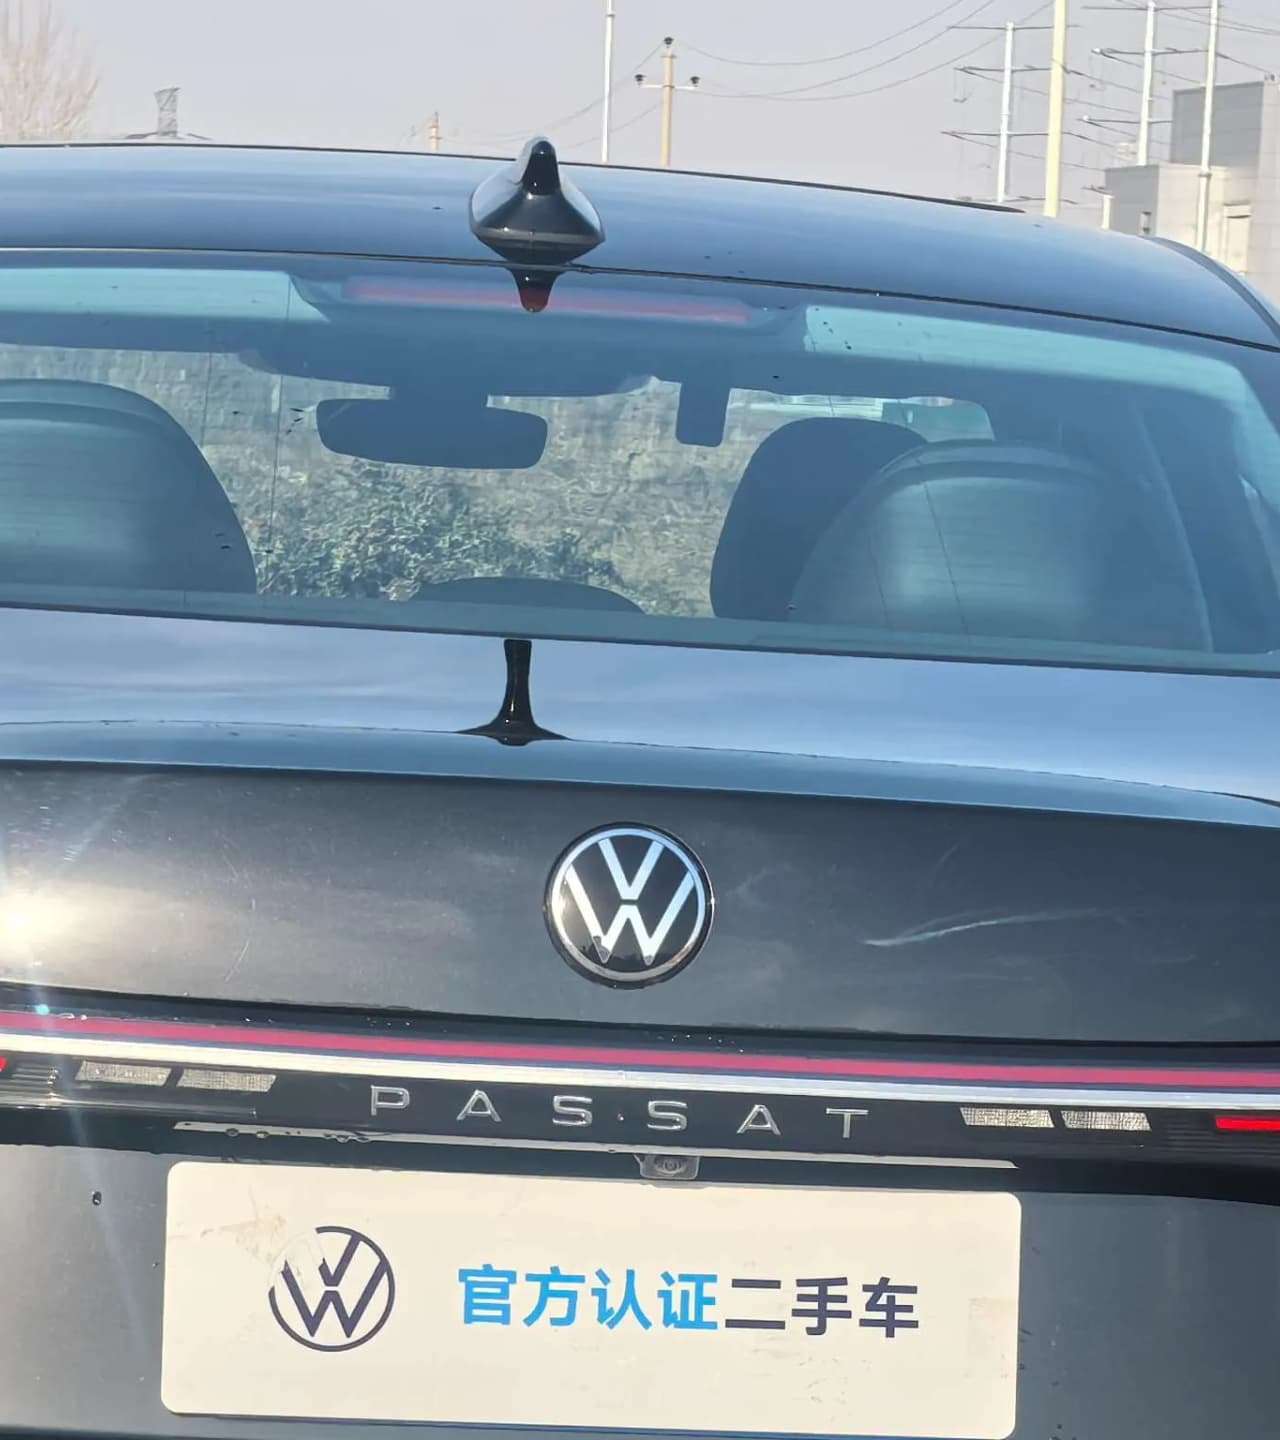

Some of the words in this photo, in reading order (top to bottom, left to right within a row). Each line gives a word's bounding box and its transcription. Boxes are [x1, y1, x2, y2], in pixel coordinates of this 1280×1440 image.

[561, 834, 698, 968] VW
[370, 1085, 869, 1139] PASSAT
[458, 1264, 919, 1338] 官方认证二手车
